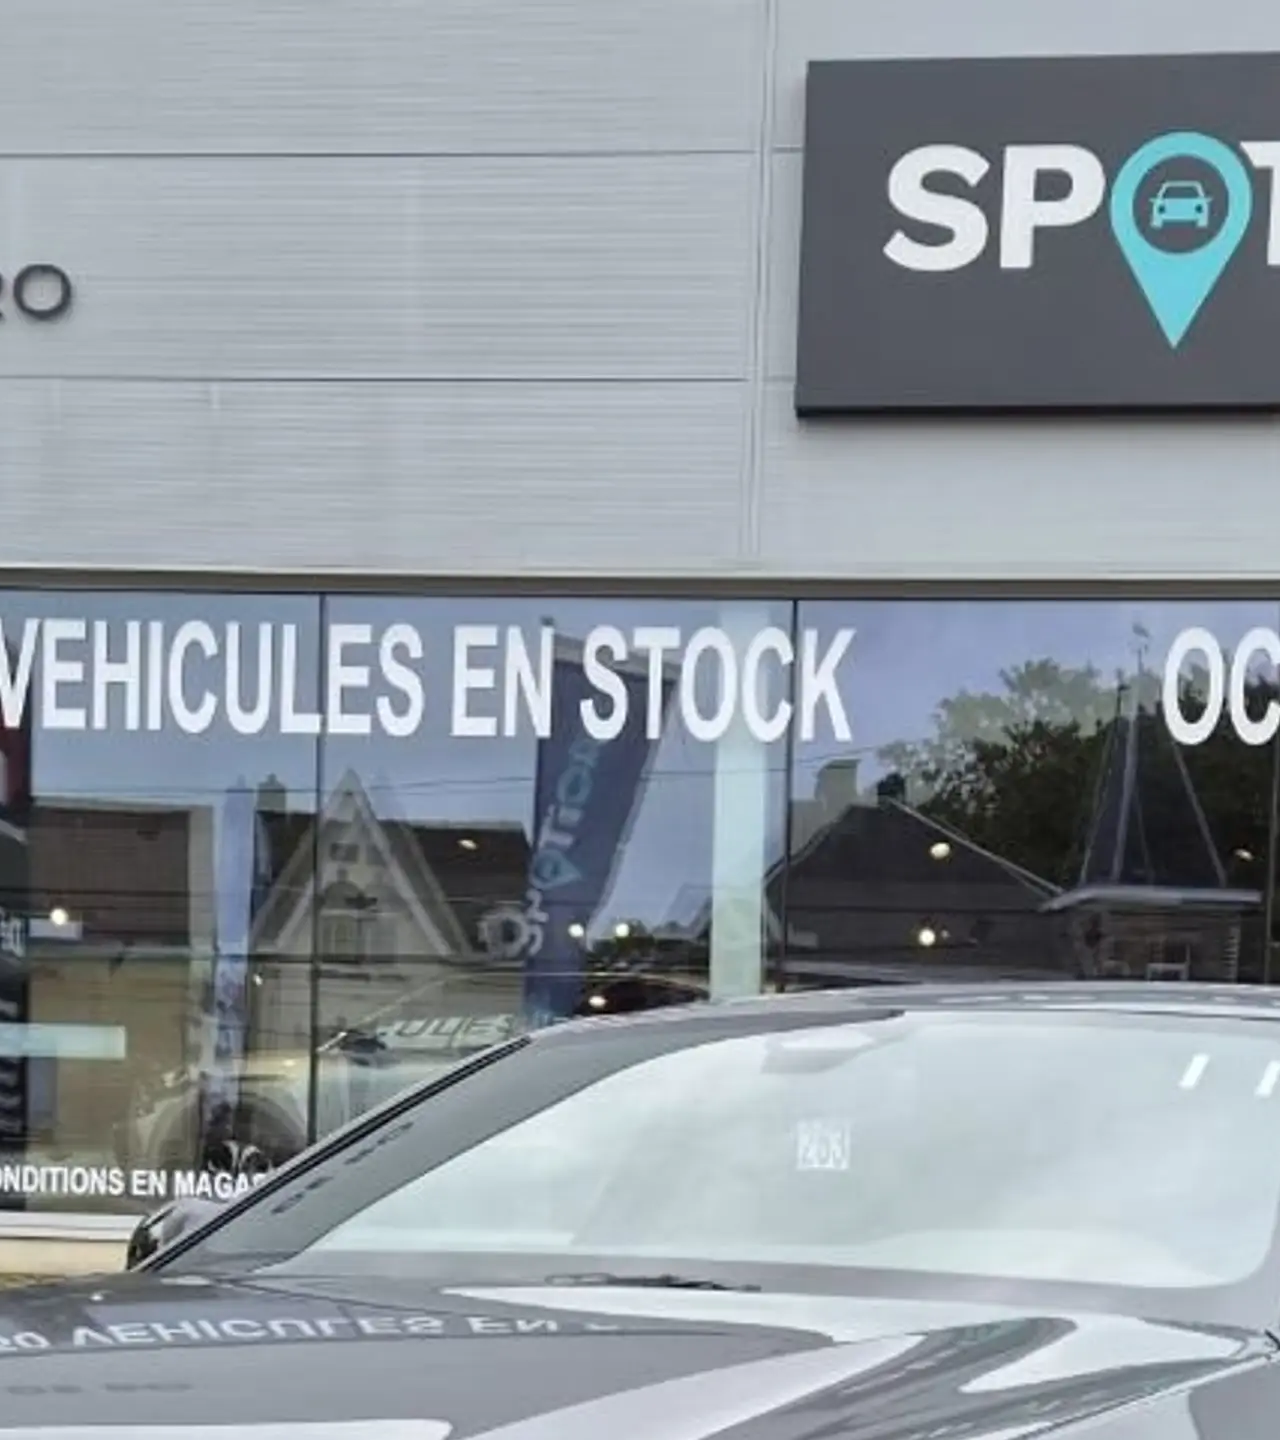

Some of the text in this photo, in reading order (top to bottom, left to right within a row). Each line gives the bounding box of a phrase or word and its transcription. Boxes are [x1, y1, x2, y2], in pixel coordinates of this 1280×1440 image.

[451, 624, 555, 738] EN
[580, 625, 858, 742] STOCK
[131, 1168, 167, 1198] EN
